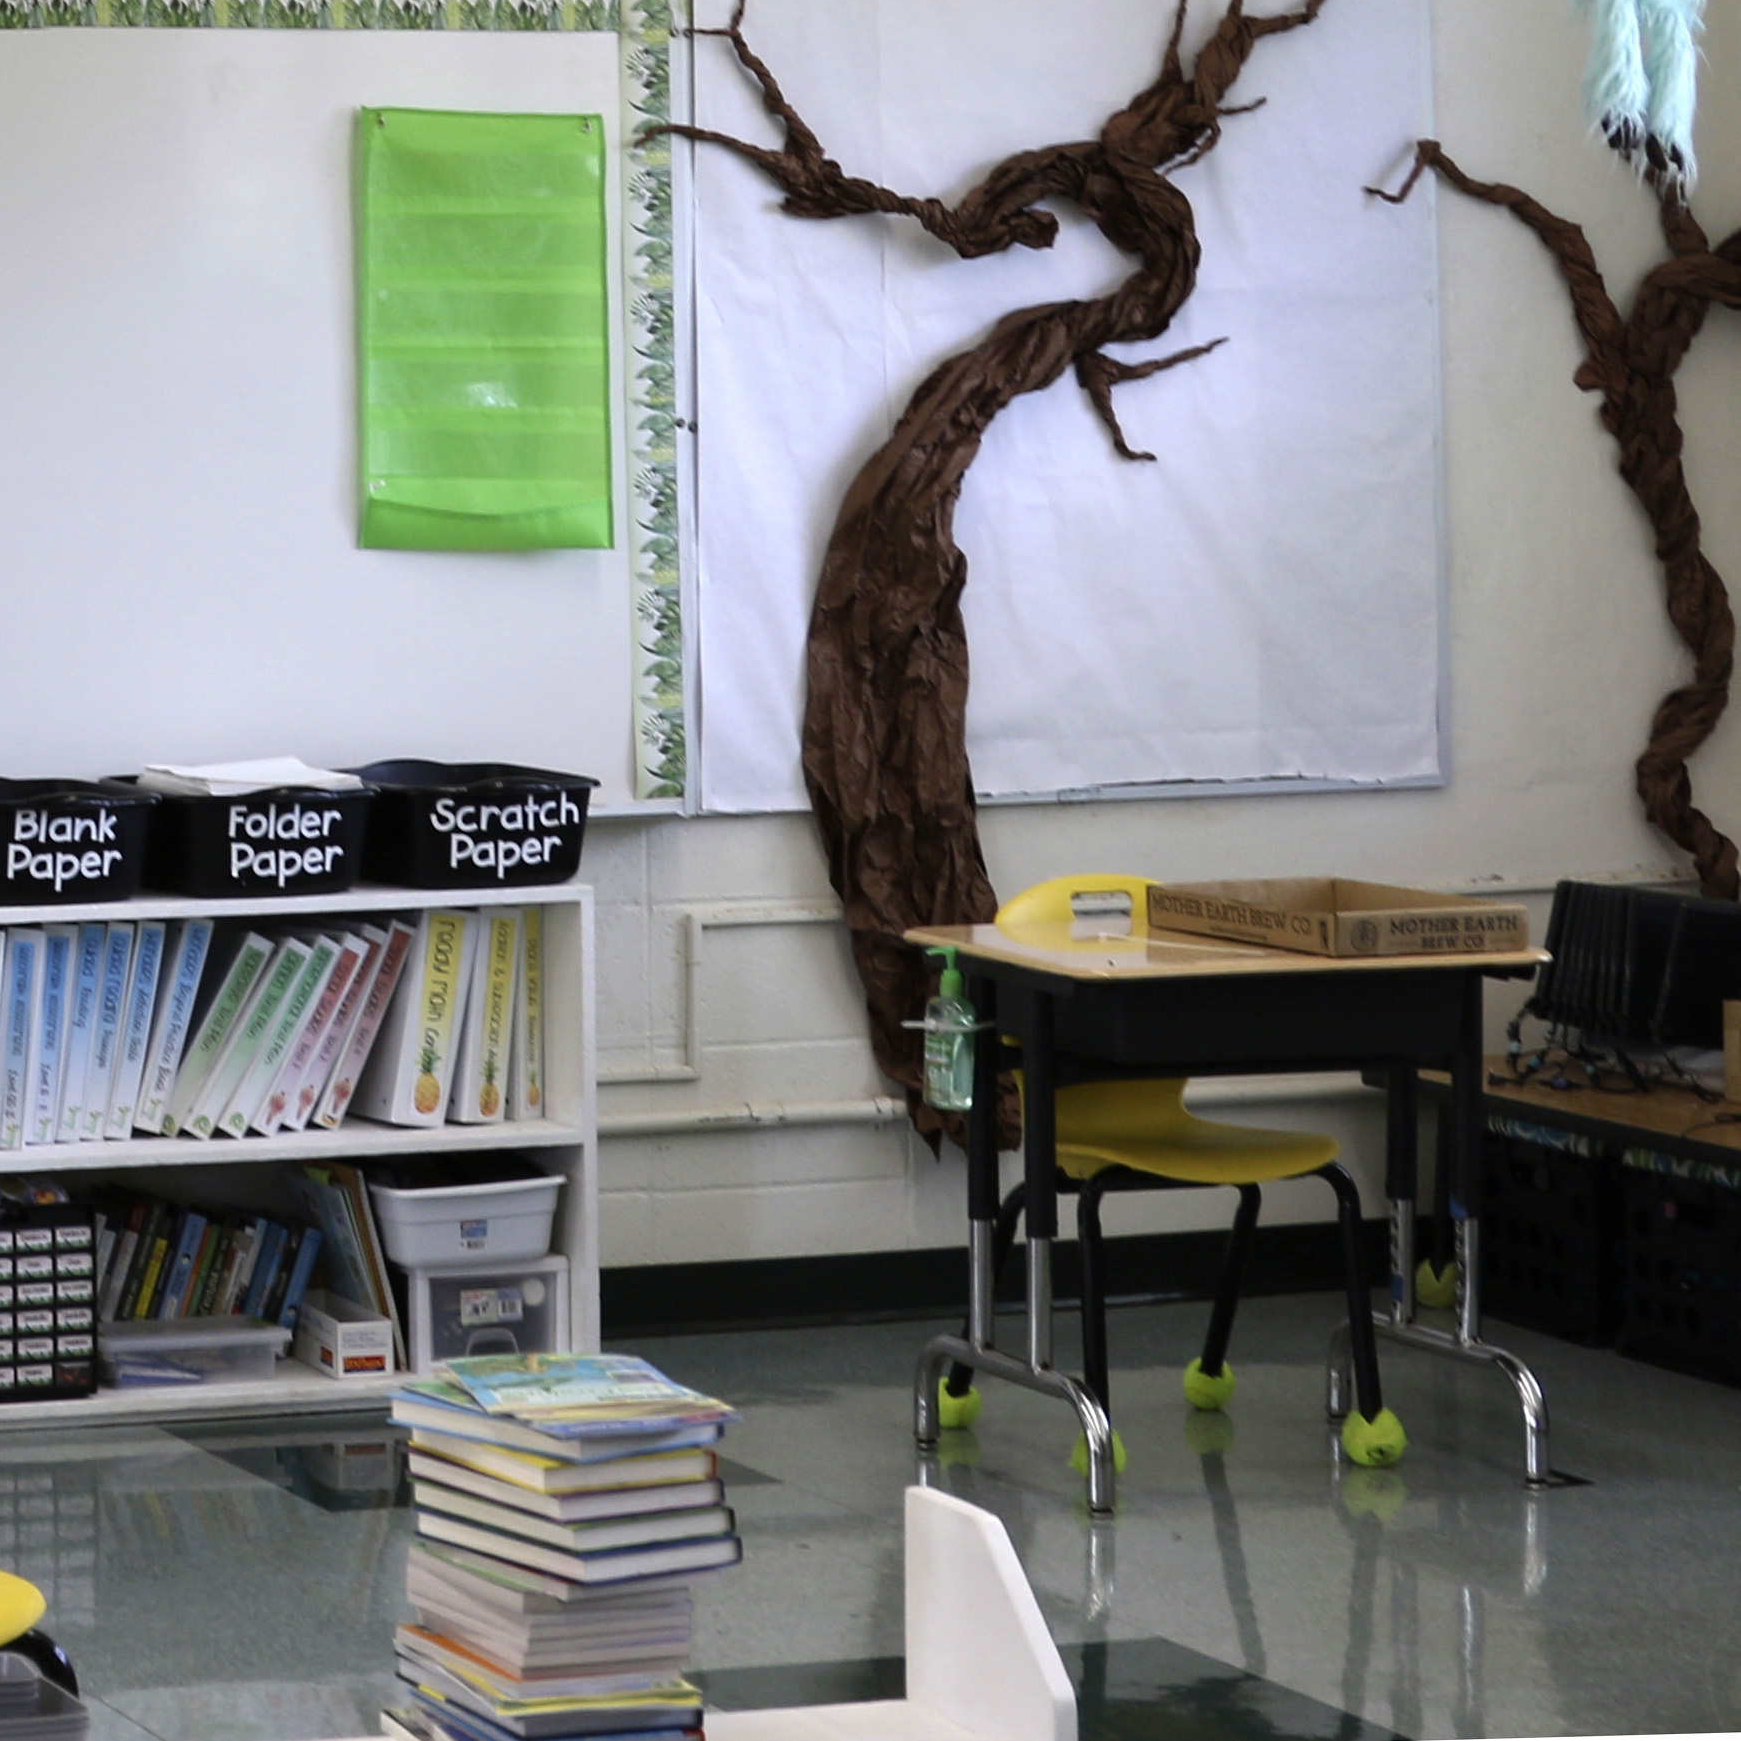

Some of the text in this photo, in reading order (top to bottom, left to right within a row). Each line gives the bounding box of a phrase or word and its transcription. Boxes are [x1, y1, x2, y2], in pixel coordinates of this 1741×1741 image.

[14, 808, 117, 843] Blank
[228, 803, 342, 840] Folder
[430, 791, 580, 832] Scratch
[7, 843, 123, 892] Paper
[230, 842, 344, 889] Paper
[450, 833, 563, 880] Paper
[1152, 893, 1204, 918] MOTHER
[1205, 901, 1248, 925] EARTH
[1250, 908, 1287, 930] BREW
[1390, 915, 1517, 935] MOTHER EARTH
[1421, 934, 1459, 950] BREW
